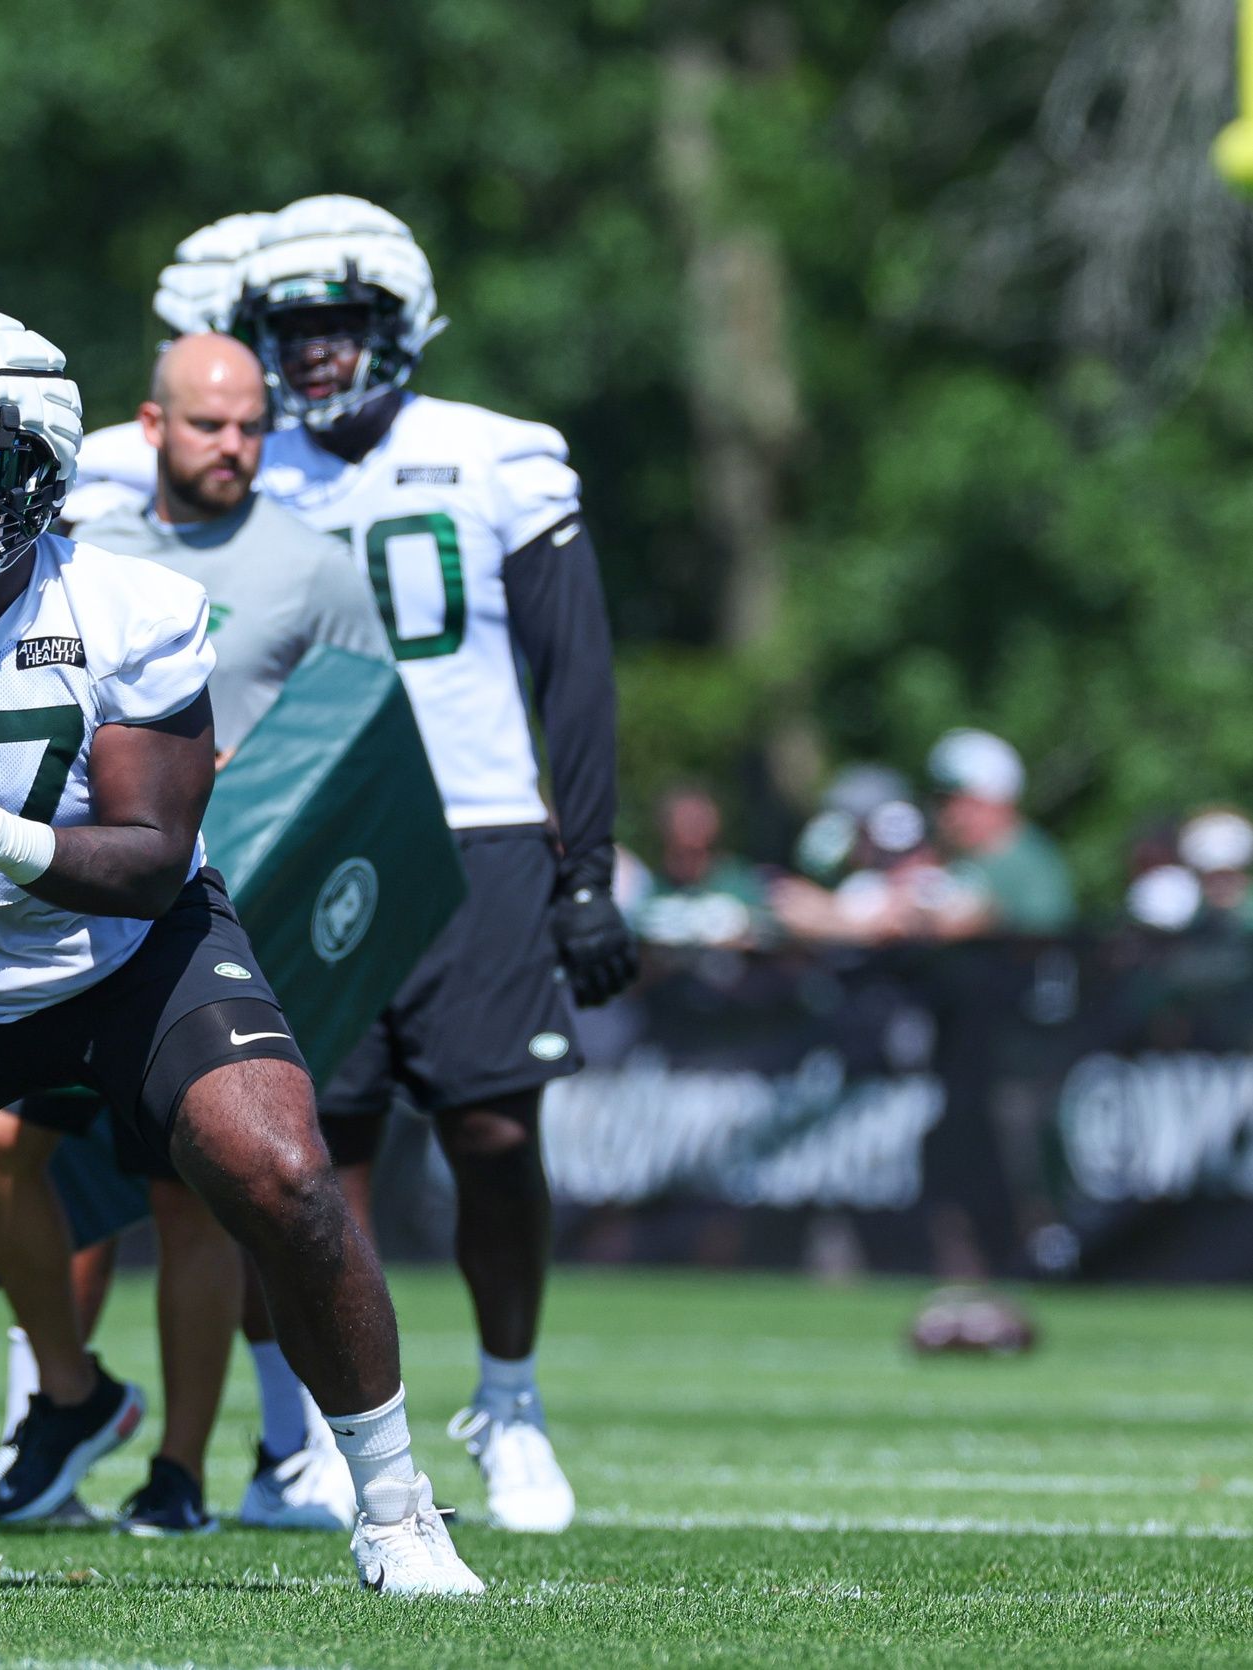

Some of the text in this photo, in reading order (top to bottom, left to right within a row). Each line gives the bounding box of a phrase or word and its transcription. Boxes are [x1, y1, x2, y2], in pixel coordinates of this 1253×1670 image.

[328, 512, 465, 662] 0
[17, 638, 84, 656] ATLANTIC
[25, 649, 76, 667] HEALTH
